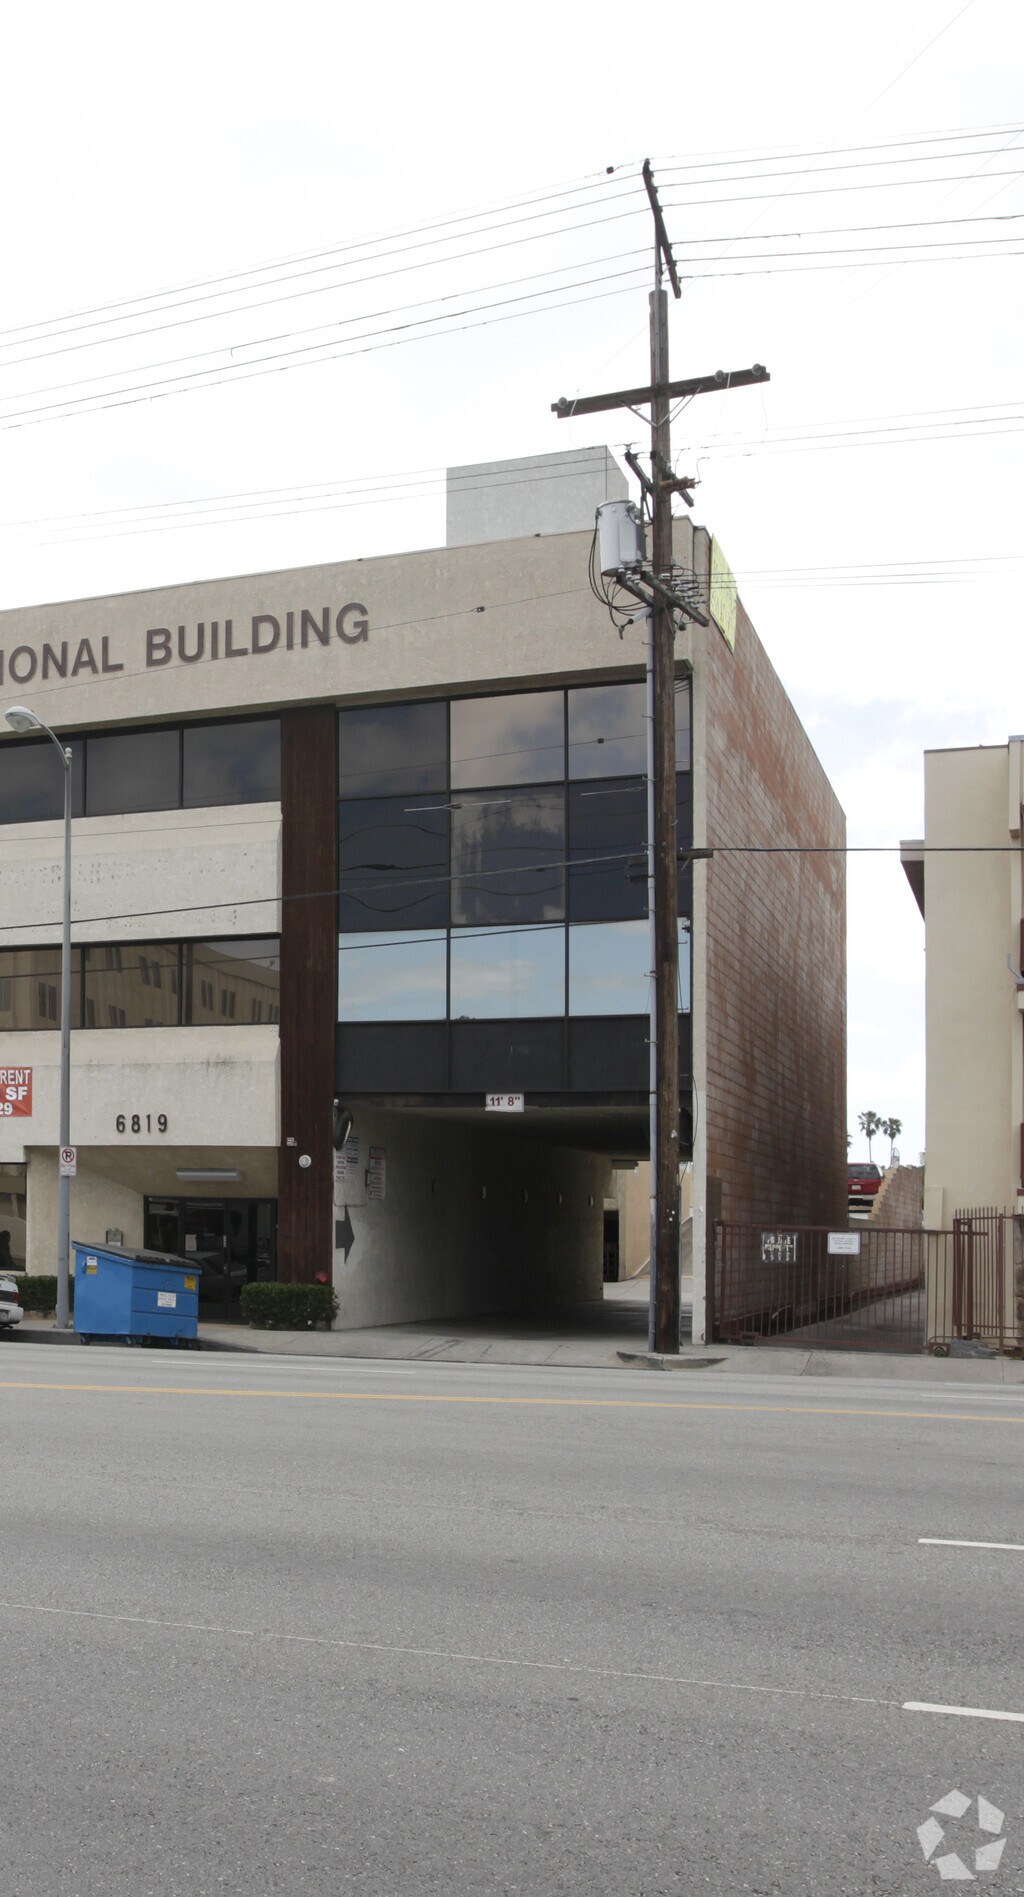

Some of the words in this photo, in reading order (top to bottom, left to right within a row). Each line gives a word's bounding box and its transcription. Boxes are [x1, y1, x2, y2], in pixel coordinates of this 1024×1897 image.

[146, 602, 369, 667] BUILDING
[0, 1069, 31, 1085] RENT
[5, 1086, 28, 1101] SF
[116, 1114, 167, 1133] 6819
